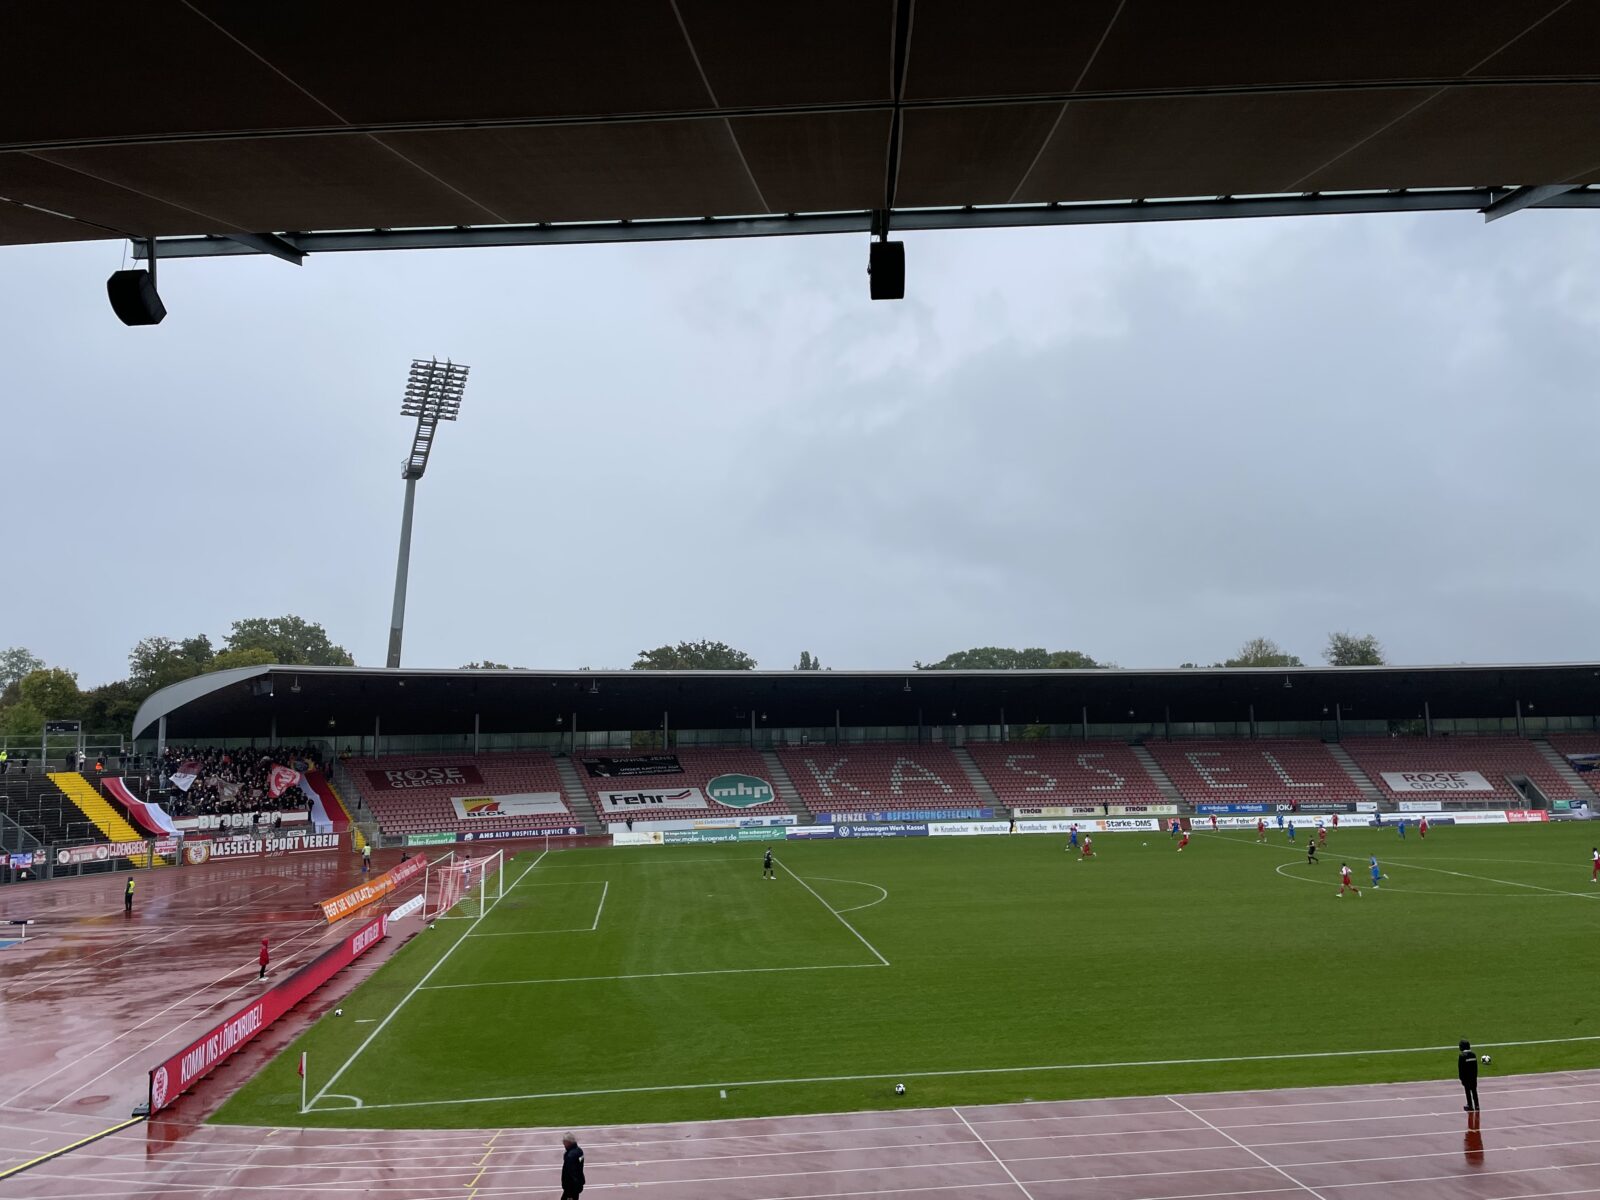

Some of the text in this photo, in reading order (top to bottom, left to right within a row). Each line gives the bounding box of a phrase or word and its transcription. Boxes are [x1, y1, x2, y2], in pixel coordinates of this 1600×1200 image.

[385, 767, 463, 781] ROSE
[1402, 773, 1465, 783] ROSE
[713, 783, 769, 798] mhp
[1410, 782, 1468, 790] GROUP
[609, 793, 664, 805] Fehr
[198, 812, 254, 829] BLOCK
[831, 813, 867, 823] BRENZEL
[940, 825, 969, 833] Krombacher
[980, 825, 1008, 833] Krombacher
[1020, 823, 1047, 831] Krombacher
[1106, 820, 1152, 828] Starke-DMS
[541, 828, 564, 836] SERVICE
[210, 840, 262, 856] KASSELER
[266, 837, 300, 852] SPORT
[303, 834, 339, 848] VEREIN
[181, 1003, 263, 1084] KOMM INS LÖWENRUDEL!
